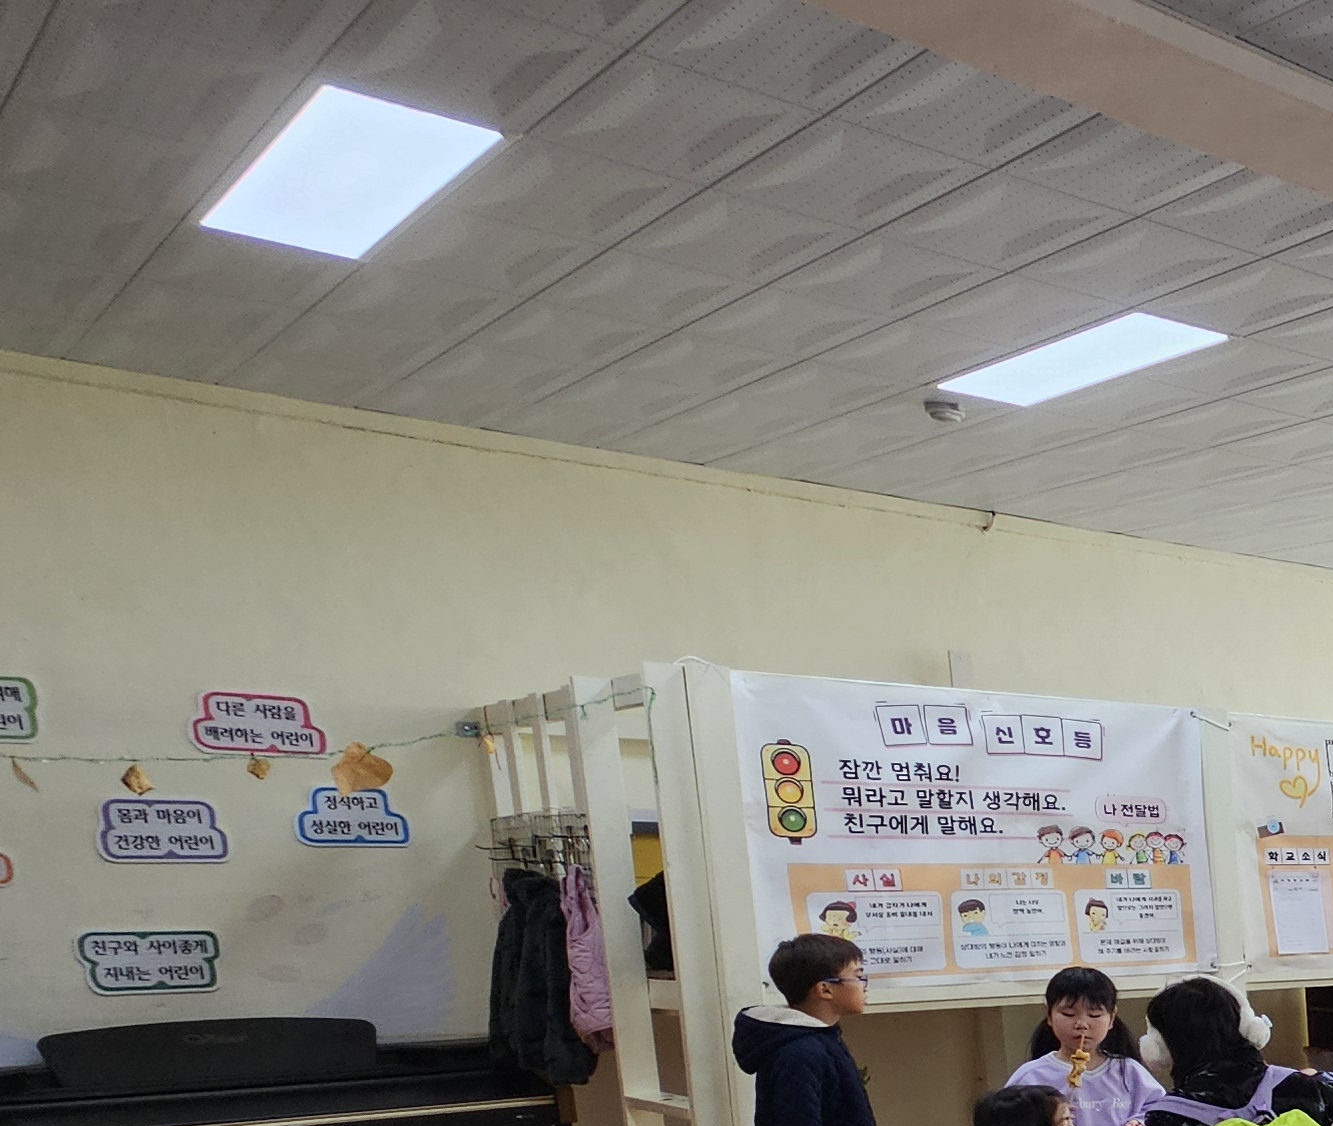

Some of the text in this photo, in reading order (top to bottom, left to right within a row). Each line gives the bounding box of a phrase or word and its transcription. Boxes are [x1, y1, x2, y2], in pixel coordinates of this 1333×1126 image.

[216, 701, 297, 721] 다른 사람을
[204, 726, 314, 748] 배려하는 어린이
[890, 716, 1093, 751] 마음 신호등
[1250, 735, 1322, 788] Happy
[838, 759, 960, 783] 잠깐 멈춰요!
[841, 786, 1066, 813] 뭐라고 말할지 생각해요.
[117, 808, 202, 824] 몸과 마음이
[1102, 802, 1160, 819] 나 전달법
[311, 821, 399, 836] 성실한 어린이
[844, 813, 1004, 836] 친구에게 말해요.
[114, 835, 215, 850] 건강한 어린이
[1267, 850, 1327, 862] 학교소식
[852, 873, 896, 887] 사실
[91, 939, 208, 955] 친구와 사이좋게
[103, 965, 205, 981] 지내는 어린이
